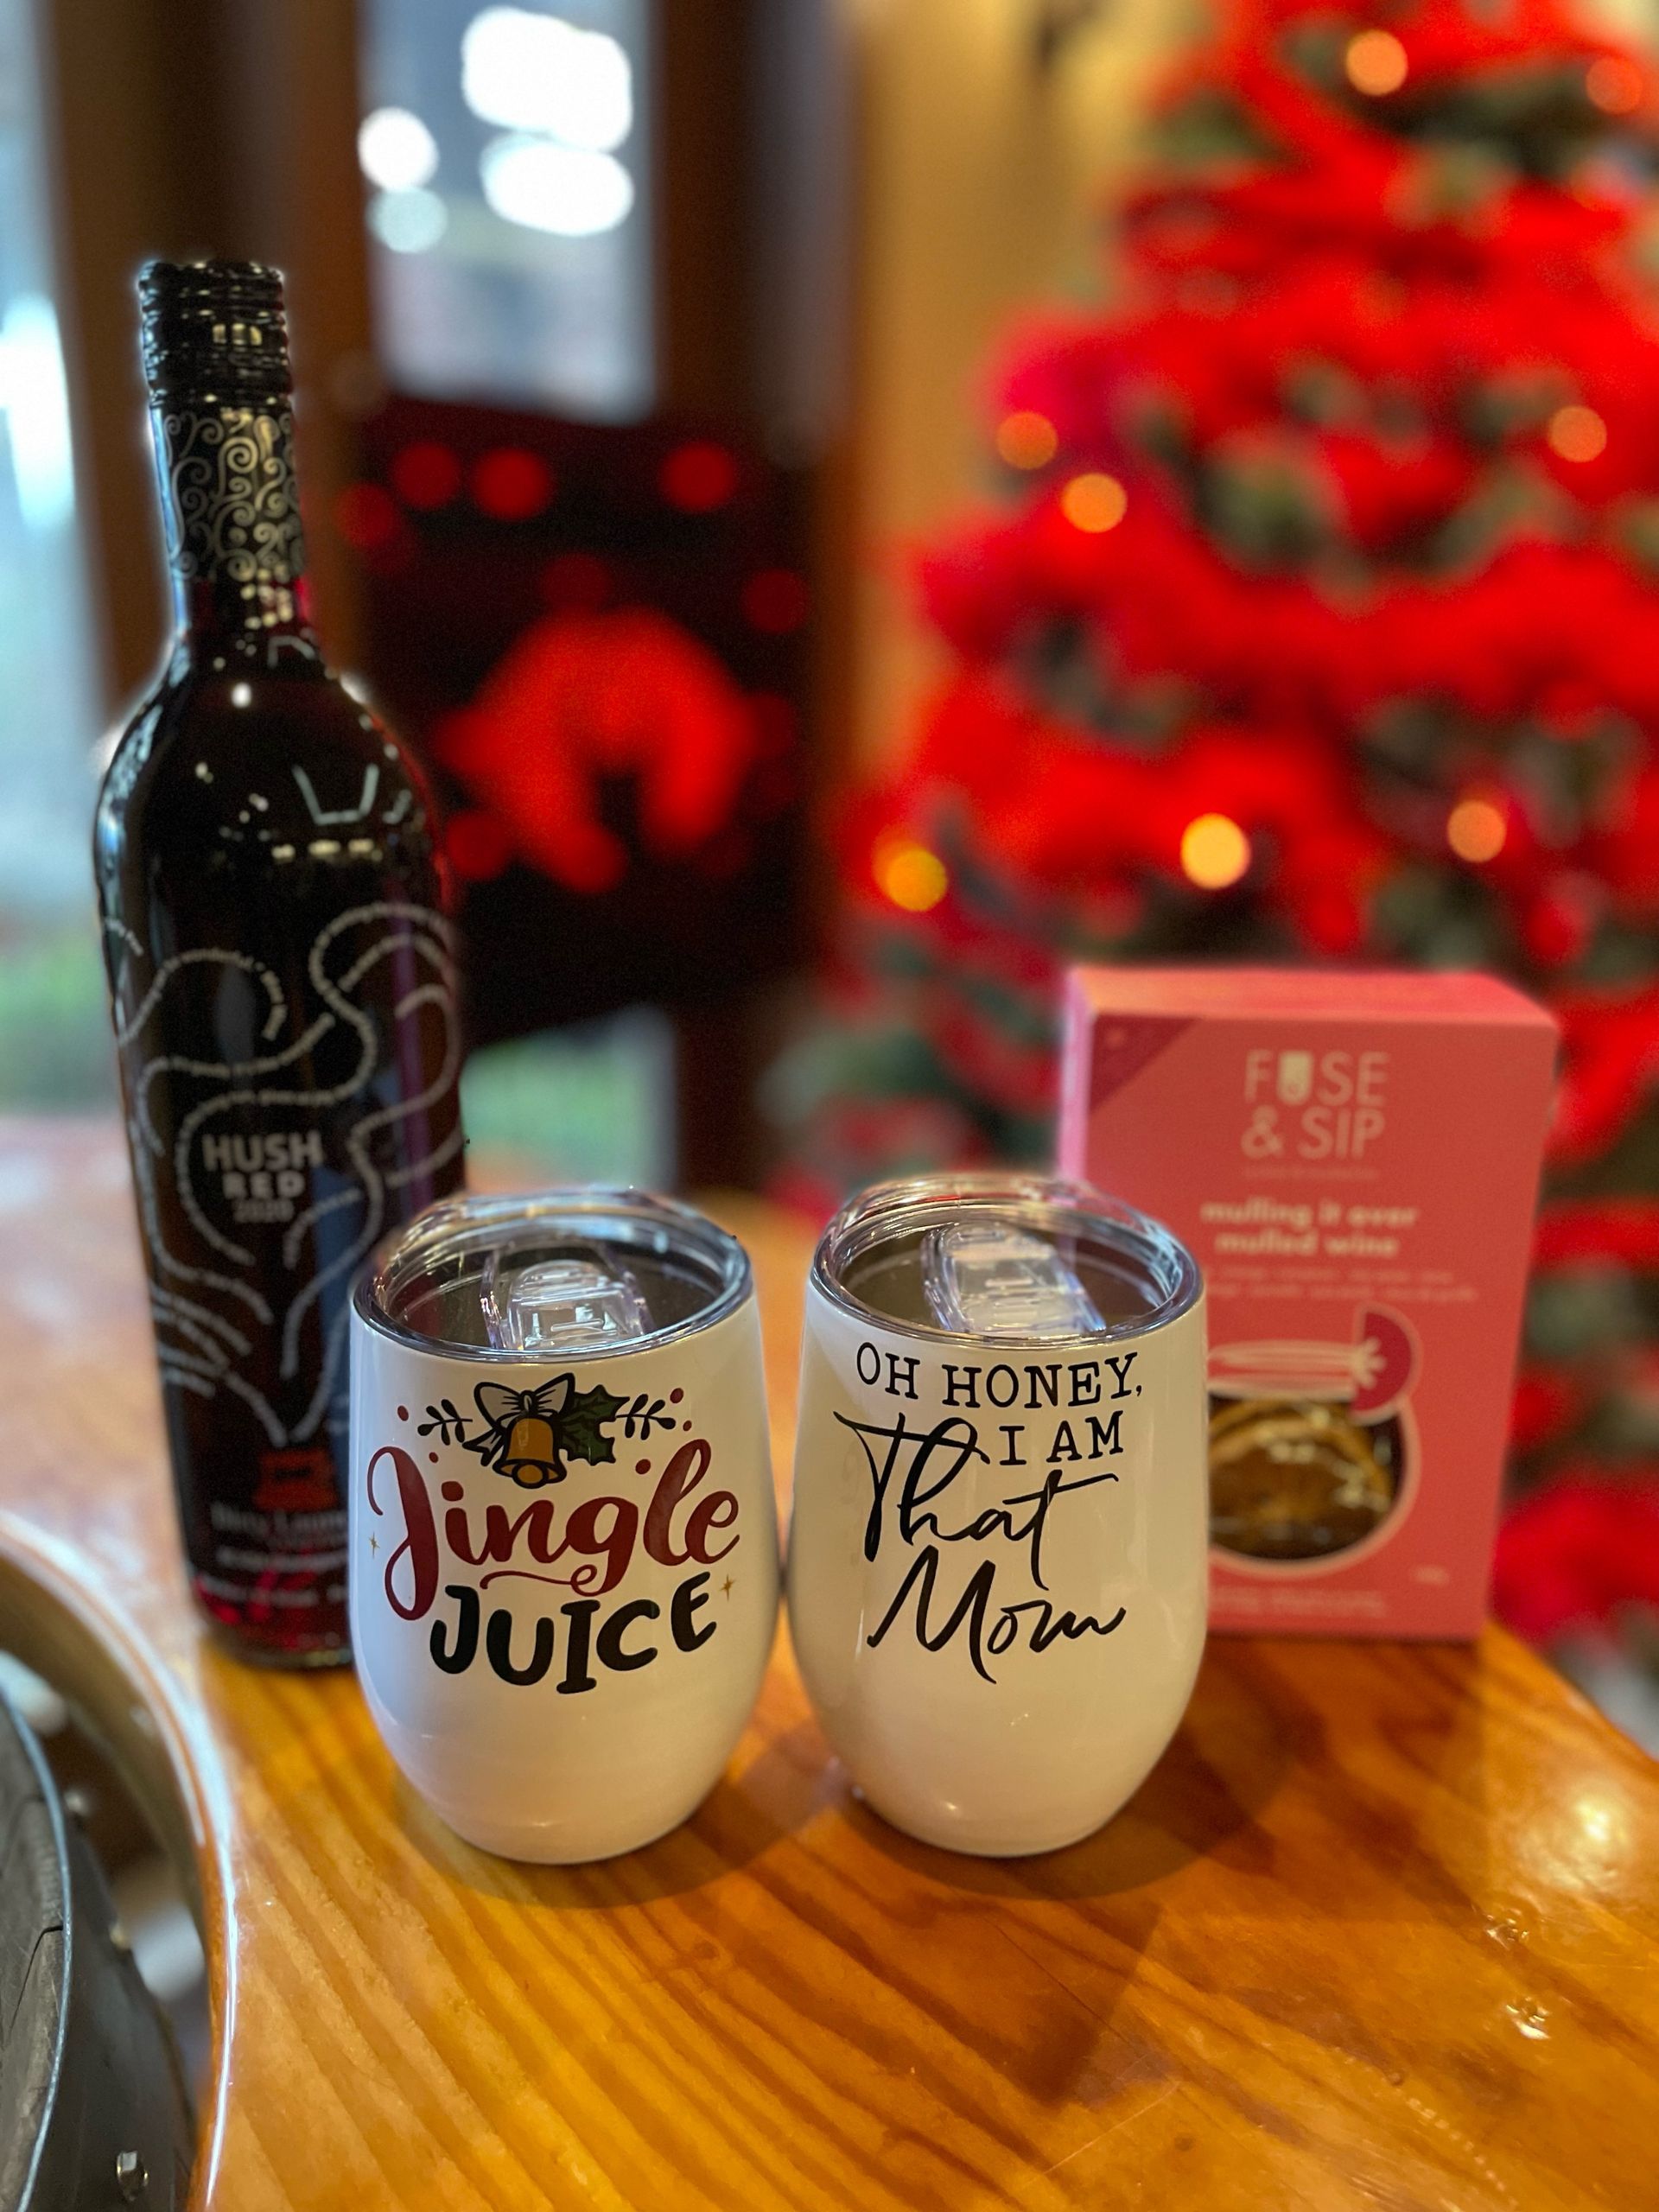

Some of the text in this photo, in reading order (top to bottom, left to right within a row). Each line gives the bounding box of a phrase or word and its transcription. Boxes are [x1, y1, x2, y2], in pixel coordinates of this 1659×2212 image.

[1244, 1050, 1389, 1106] FUSE
[201, 1129, 323, 1171] HUSH
[1241, 1105, 1384, 1160] & SIP
[222, 1171, 305, 1199] RED
[1201, 1198, 1312, 1230] mulling
[1319, 1198, 1340, 1224] it
[1215, 1228, 1400, 1257] mulled wine
[856, 1342, 1142, 1408] OH HONEY,
[999, 1410, 1124, 1465] I AM
[832, 1411, 1119, 1592] That
[367, 1439, 740, 1621] Jingle
[429, 1571, 716, 1694] JUICE
[867, 1544, 1127, 1685] Mom
